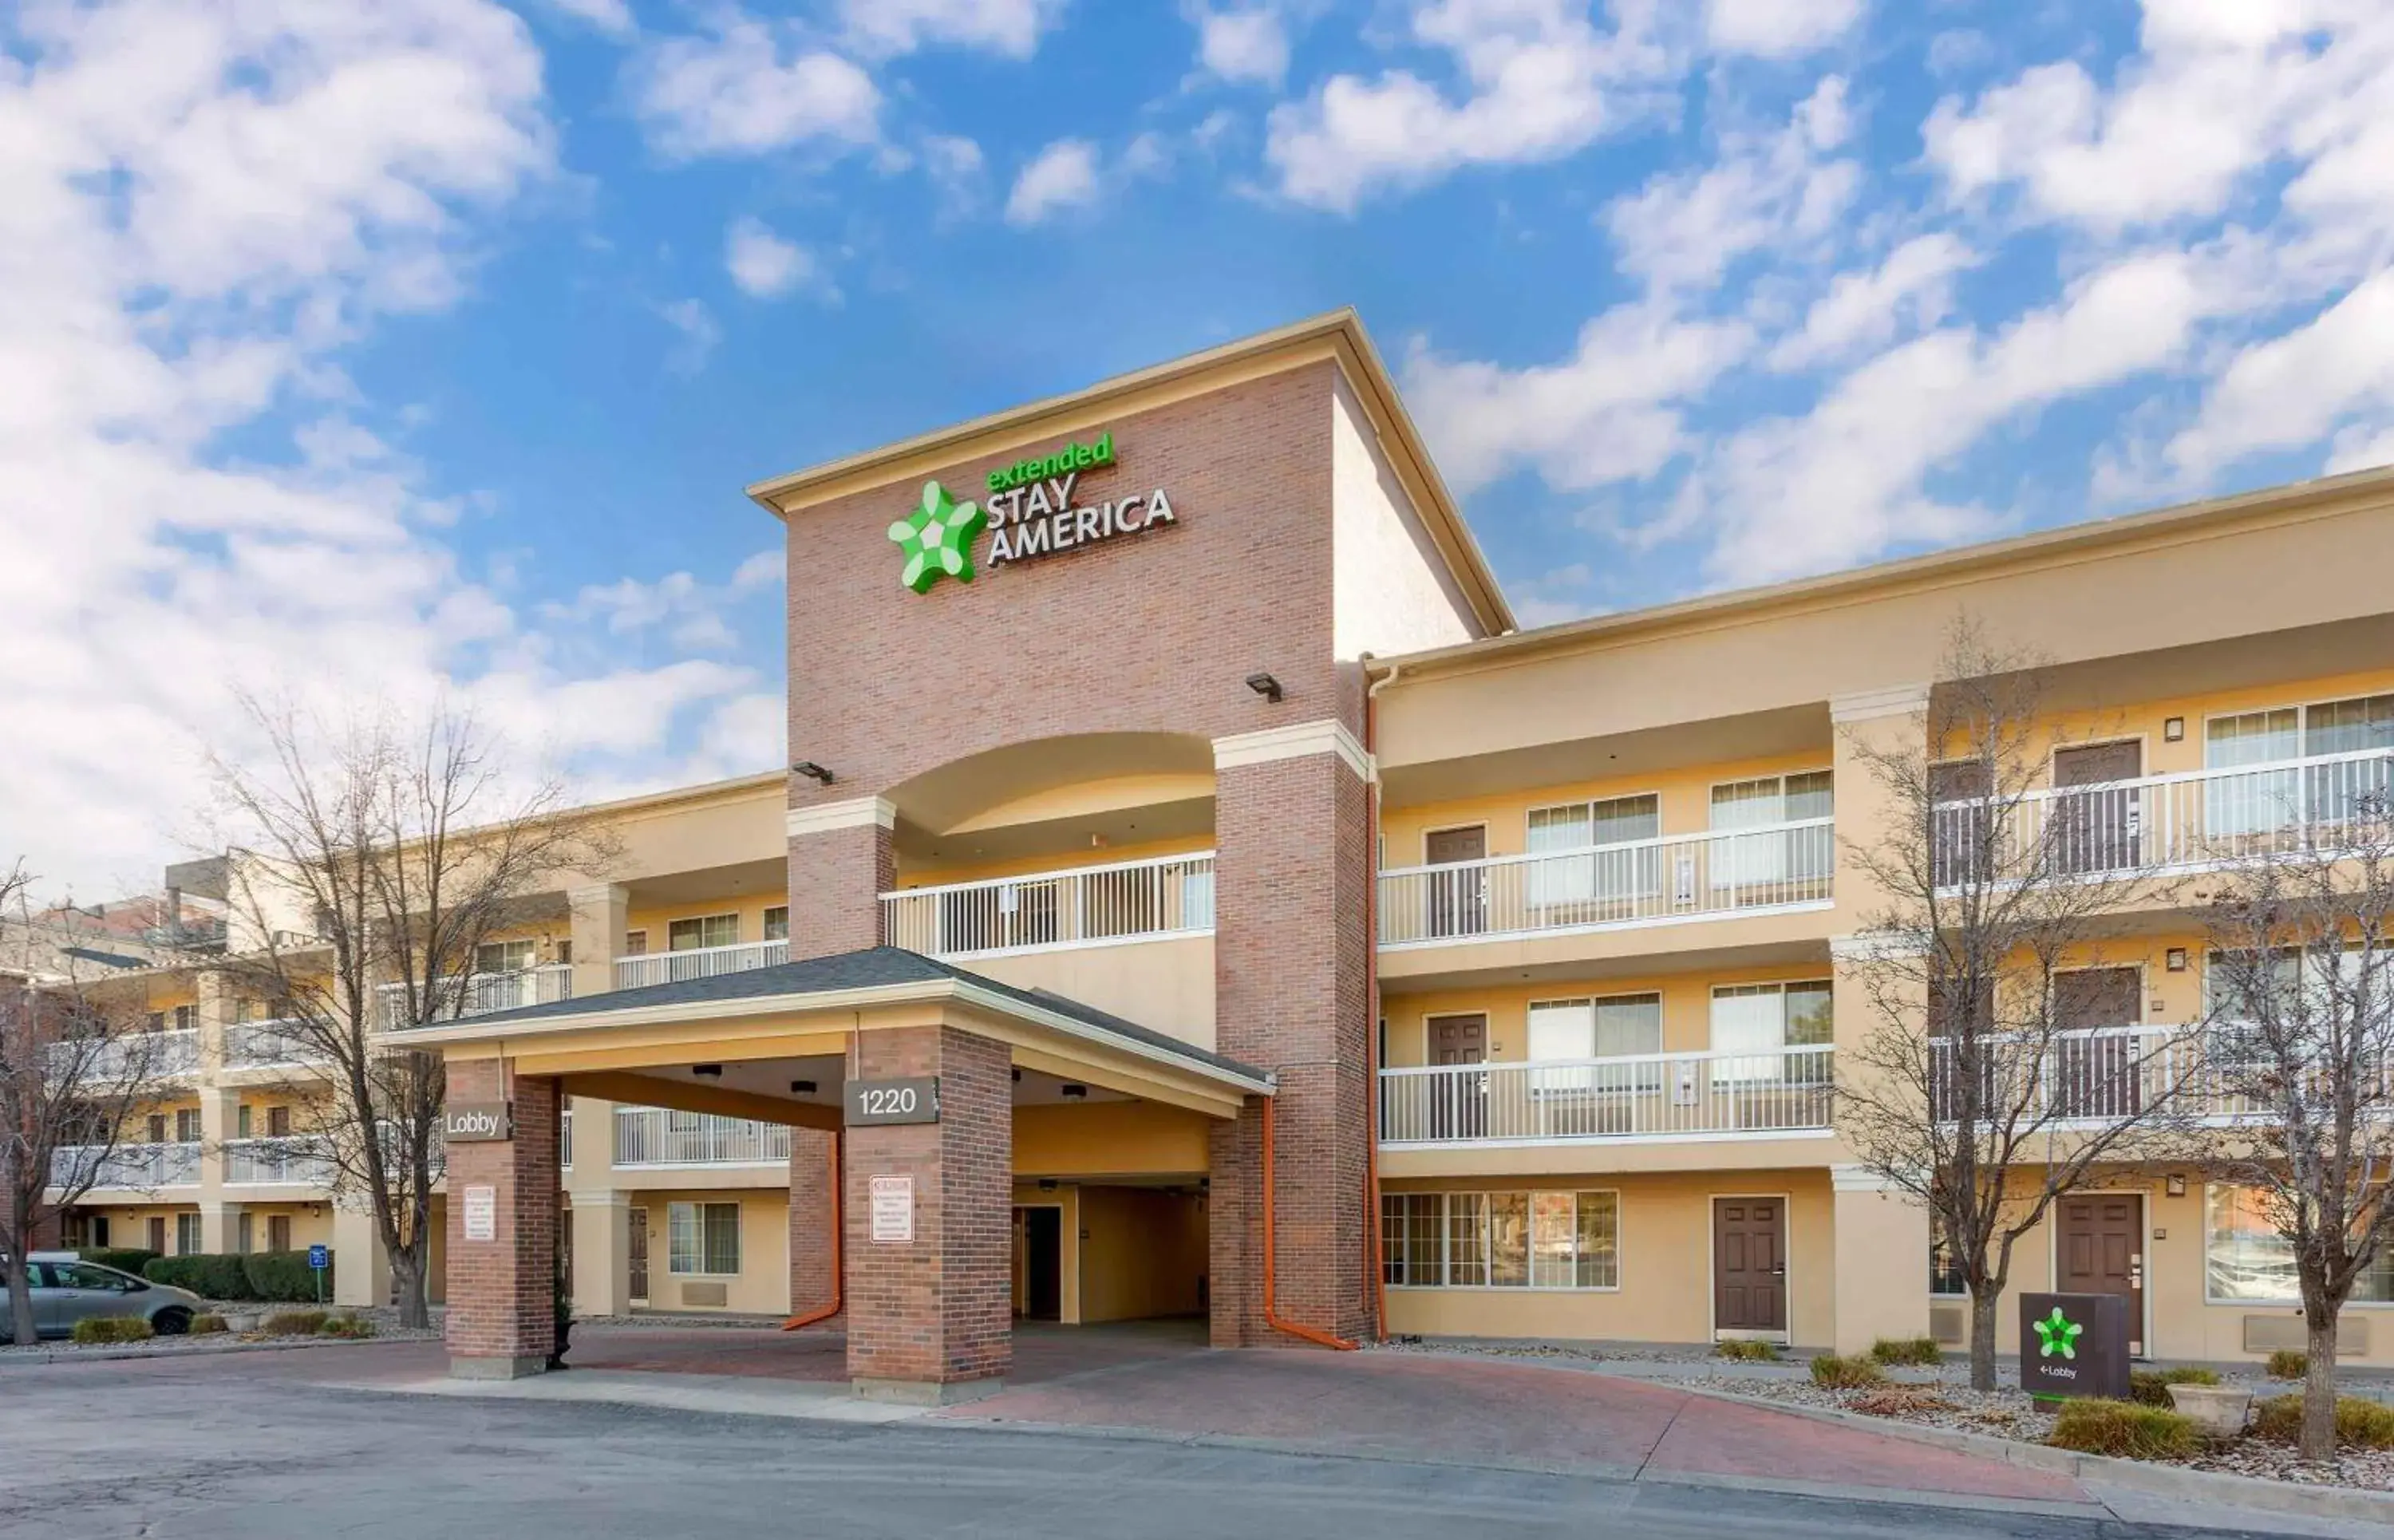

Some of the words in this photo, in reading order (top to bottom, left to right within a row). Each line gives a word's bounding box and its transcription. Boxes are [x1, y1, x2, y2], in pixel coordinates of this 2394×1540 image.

[986, 432, 1115, 492] extended
[986, 472, 1079, 529] STAY
[986, 488, 1175, 567] AMERICA
[859, 1088, 916, 1115] 1220
[447, 1111, 500, 1136] Lobby
[2048, 1365, 2076, 1380] Lobby
